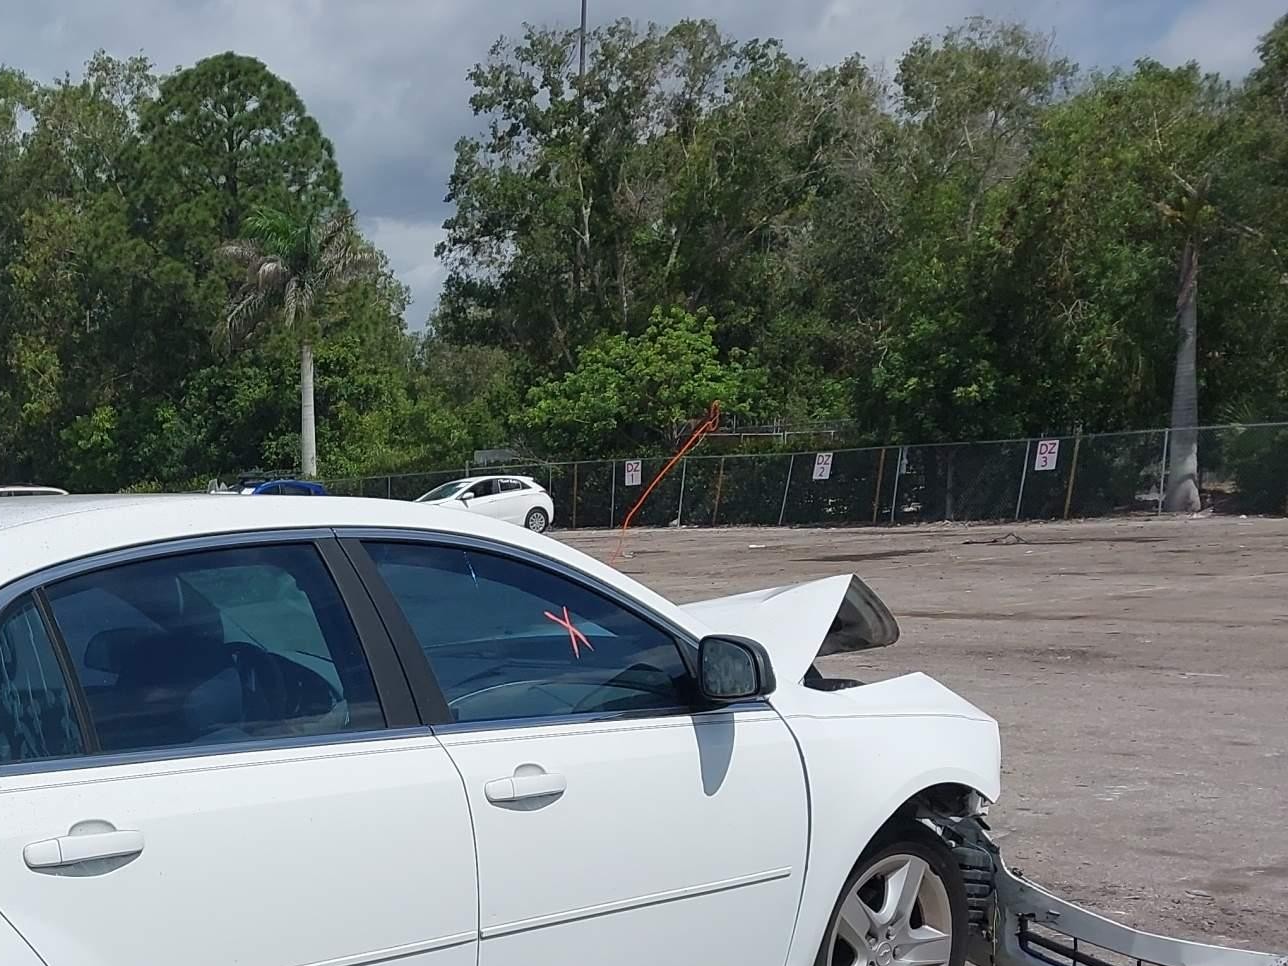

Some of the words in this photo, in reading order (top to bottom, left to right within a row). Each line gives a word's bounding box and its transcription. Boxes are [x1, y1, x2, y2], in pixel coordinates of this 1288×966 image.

[1039, 442, 1057, 455] DZ
[817, 454, 832, 466] DZ
[1040, 456, 1048, 468] 3
[626, 461, 640, 473] DZ
[818, 466, 825, 478] 2
